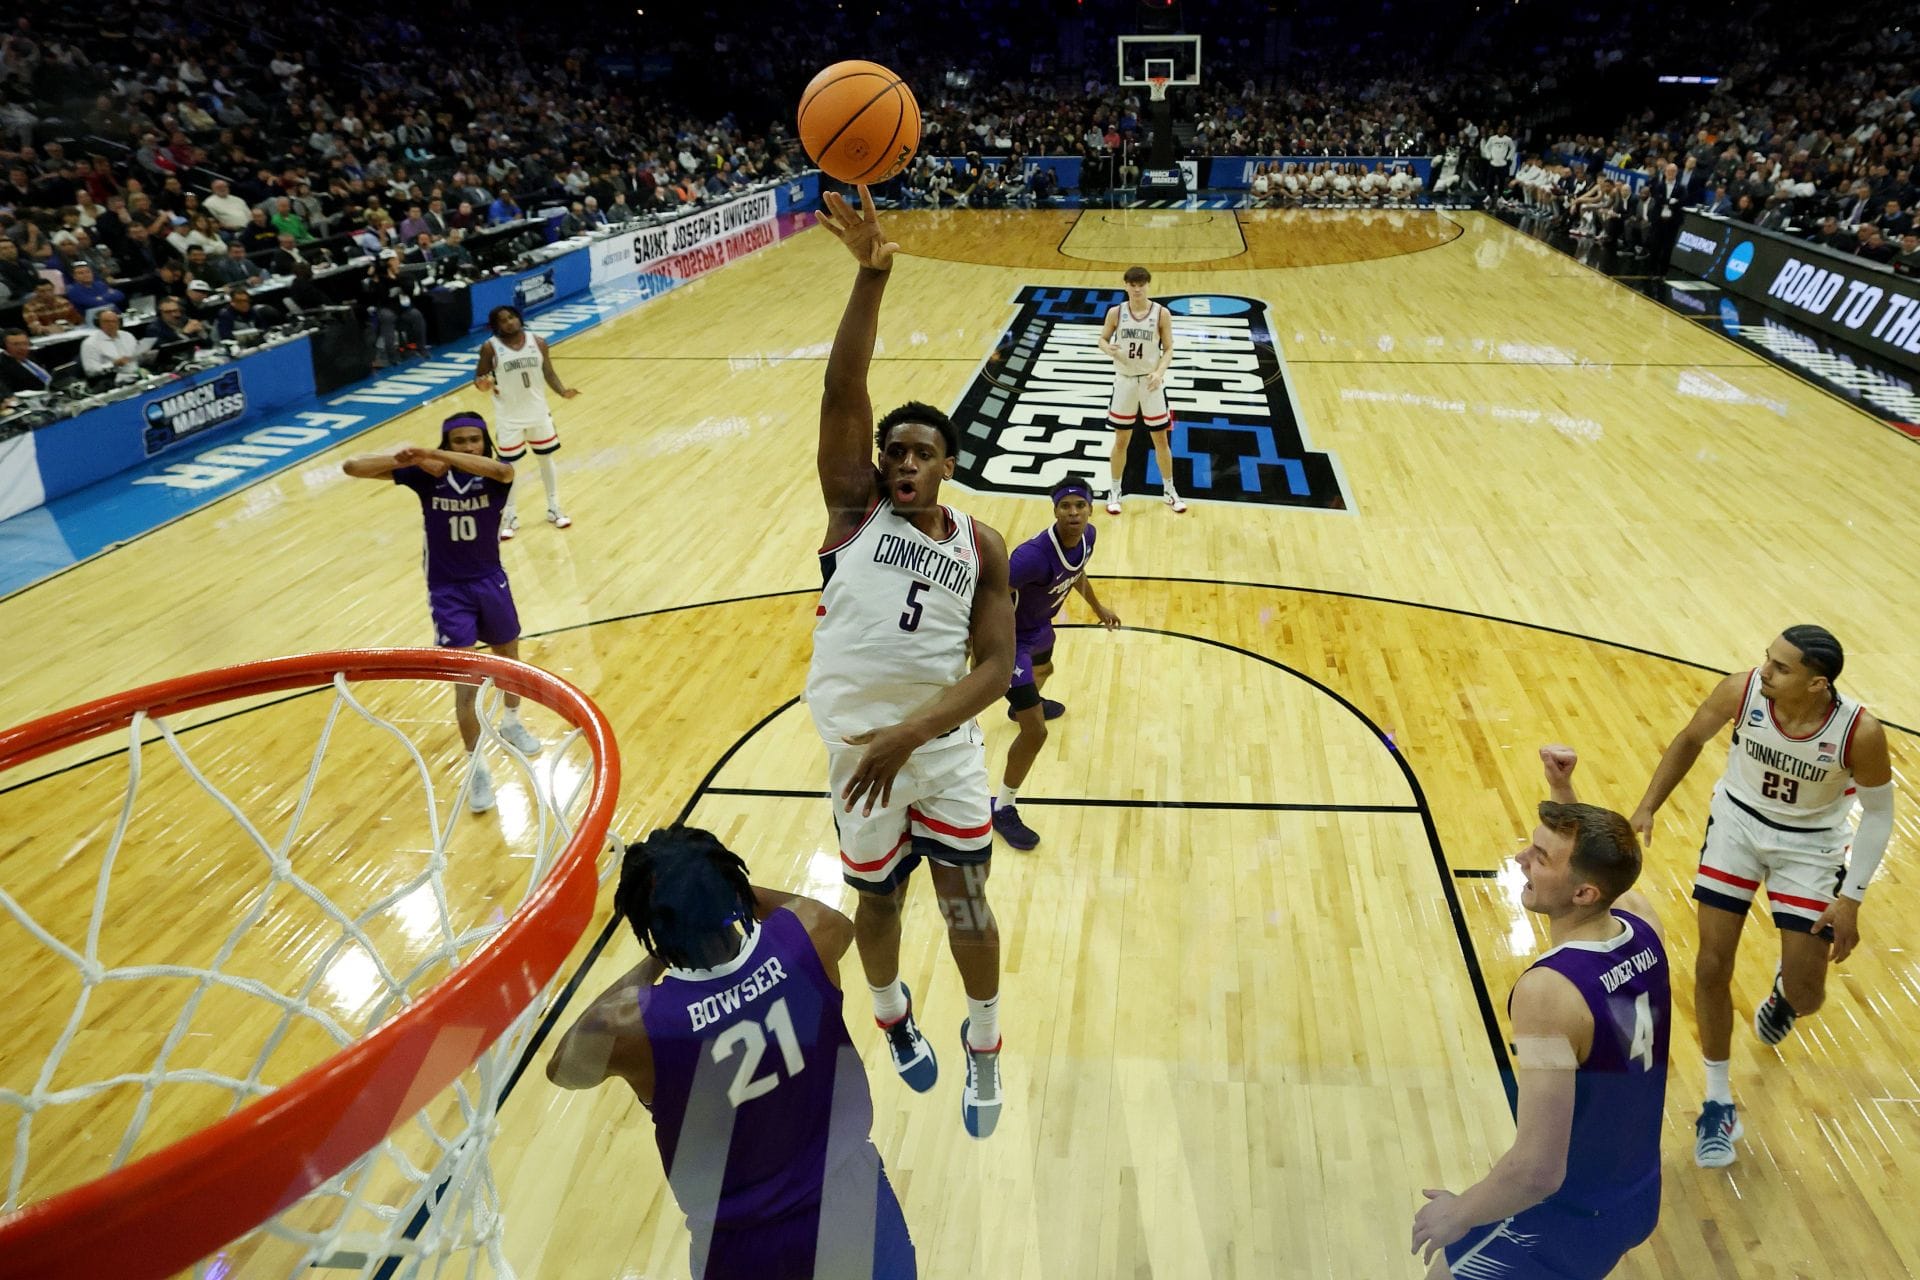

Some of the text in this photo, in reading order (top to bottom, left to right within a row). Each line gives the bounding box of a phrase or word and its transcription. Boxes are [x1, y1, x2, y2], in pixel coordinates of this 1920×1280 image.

[633, 195, 771, 264] SAINT JOSEPH'S UNIVERSITY
[1768, 257, 1845, 315] ROAD
[1831, 279, 1884, 330] TO
[1871, 293, 1920, 355] THE
[1128, 342, 1144, 360] 24
[1164, 315, 1272, 418] MARCH
[161, 383, 216, 418] MARCH
[521, 371, 531, 389] 0
[172, 392, 244, 434] MADNESS
[981, 322, 1117, 496] MADNESS
[131, 411, 368, 490] FOUR
[431, 494, 491, 513] FURMAN
[448, 515, 478, 542] 10
[898, 580, 931, 633] 5
[1745, 737, 1830, 783] CONNECTICUT
[1761, 770, 1800, 805] 23
[686, 956, 788, 1033] BOWSER
[710, 995, 806, 1109] 21
[1629, 990, 1655, 1074] 4
